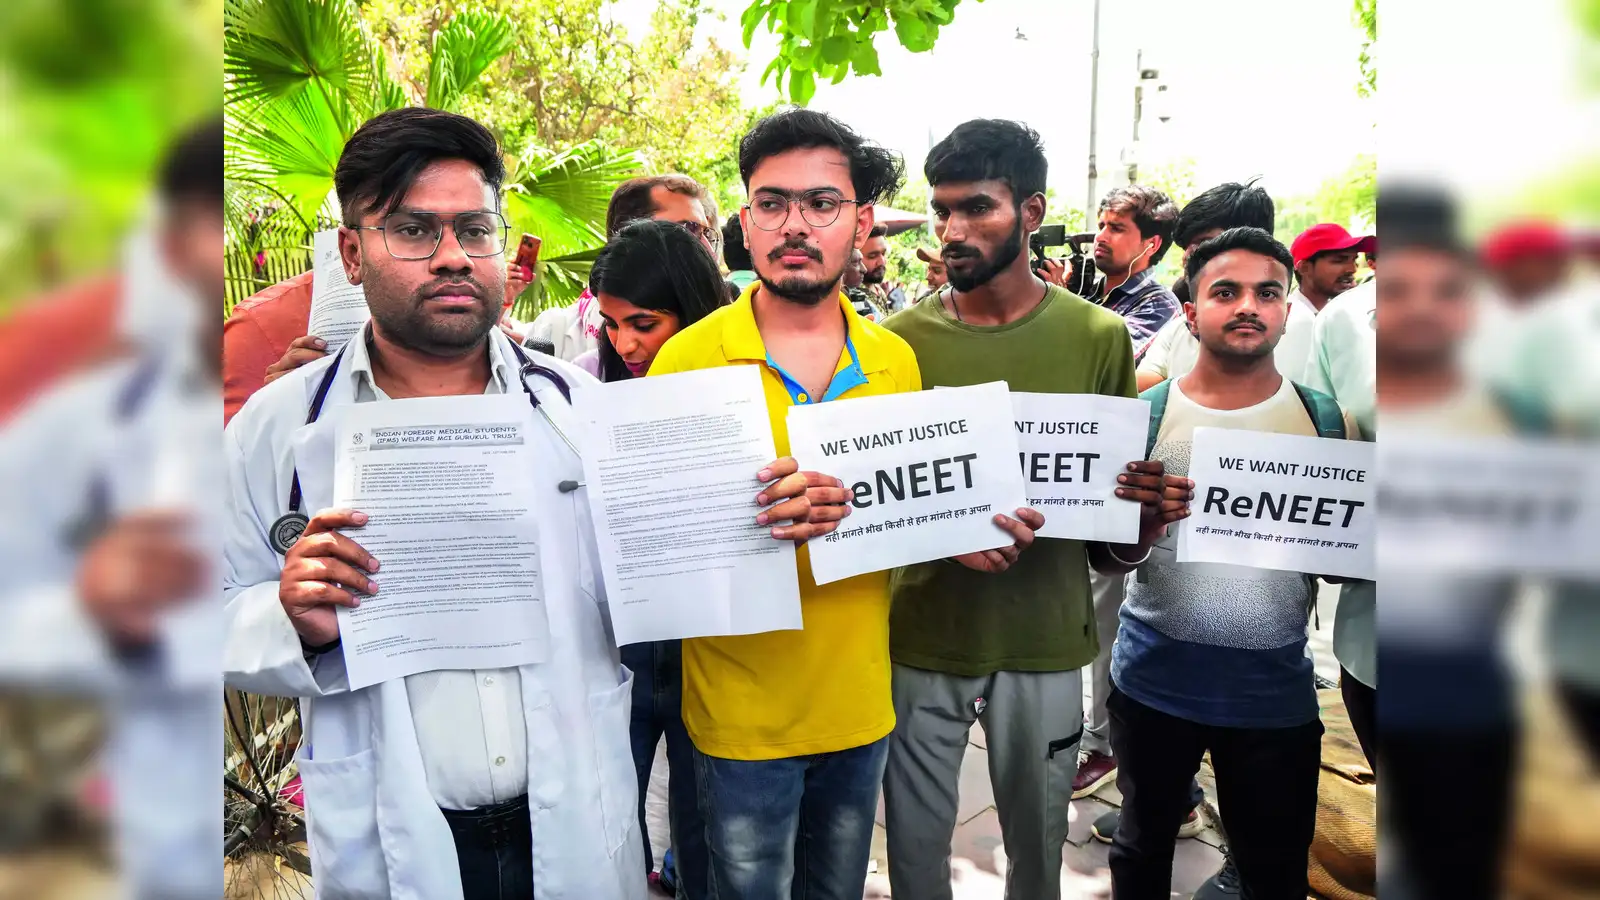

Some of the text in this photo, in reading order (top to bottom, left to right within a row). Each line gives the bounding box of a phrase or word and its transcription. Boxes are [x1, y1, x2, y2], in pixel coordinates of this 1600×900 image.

[821, 420, 968, 457] WE WANT JUSTICE
[1014, 421, 1099, 434] NT JUSTICE
[828, 453, 977, 508] eNEET
[1219, 456, 1366, 483] WE WANT JUSTICE
[1030, 498, 1042, 506] हम
[1044, 496, 1066, 506] मांगते
[1082, 499, 1105, 507] अपना
[1203, 486, 1365, 528] ReNEET
[825, 530, 840, 543] नहीं
[842, 526, 865, 539] मांगते
[866, 524, 884, 535] भीख
[885, 519, 905, 531] किसी
[907, 516, 915, 527] से
[915, 515, 928, 526] हम
[930, 510, 953, 521] मांगते
[969, 504, 992, 515] अपना
[1195, 525, 1210, 535] नहीं
[1211, 526, 1233, 537] मांगते
[1234, 530, 1252, 539] भीख
[1253, 532, 1274, 542] किसी
[1275, 534, 1282, 543] से
[1283, 536, 1296, 544] हम
[1297, 536, 1320, 547] मांगते
[1335, 541, 1359, 550] अपना
